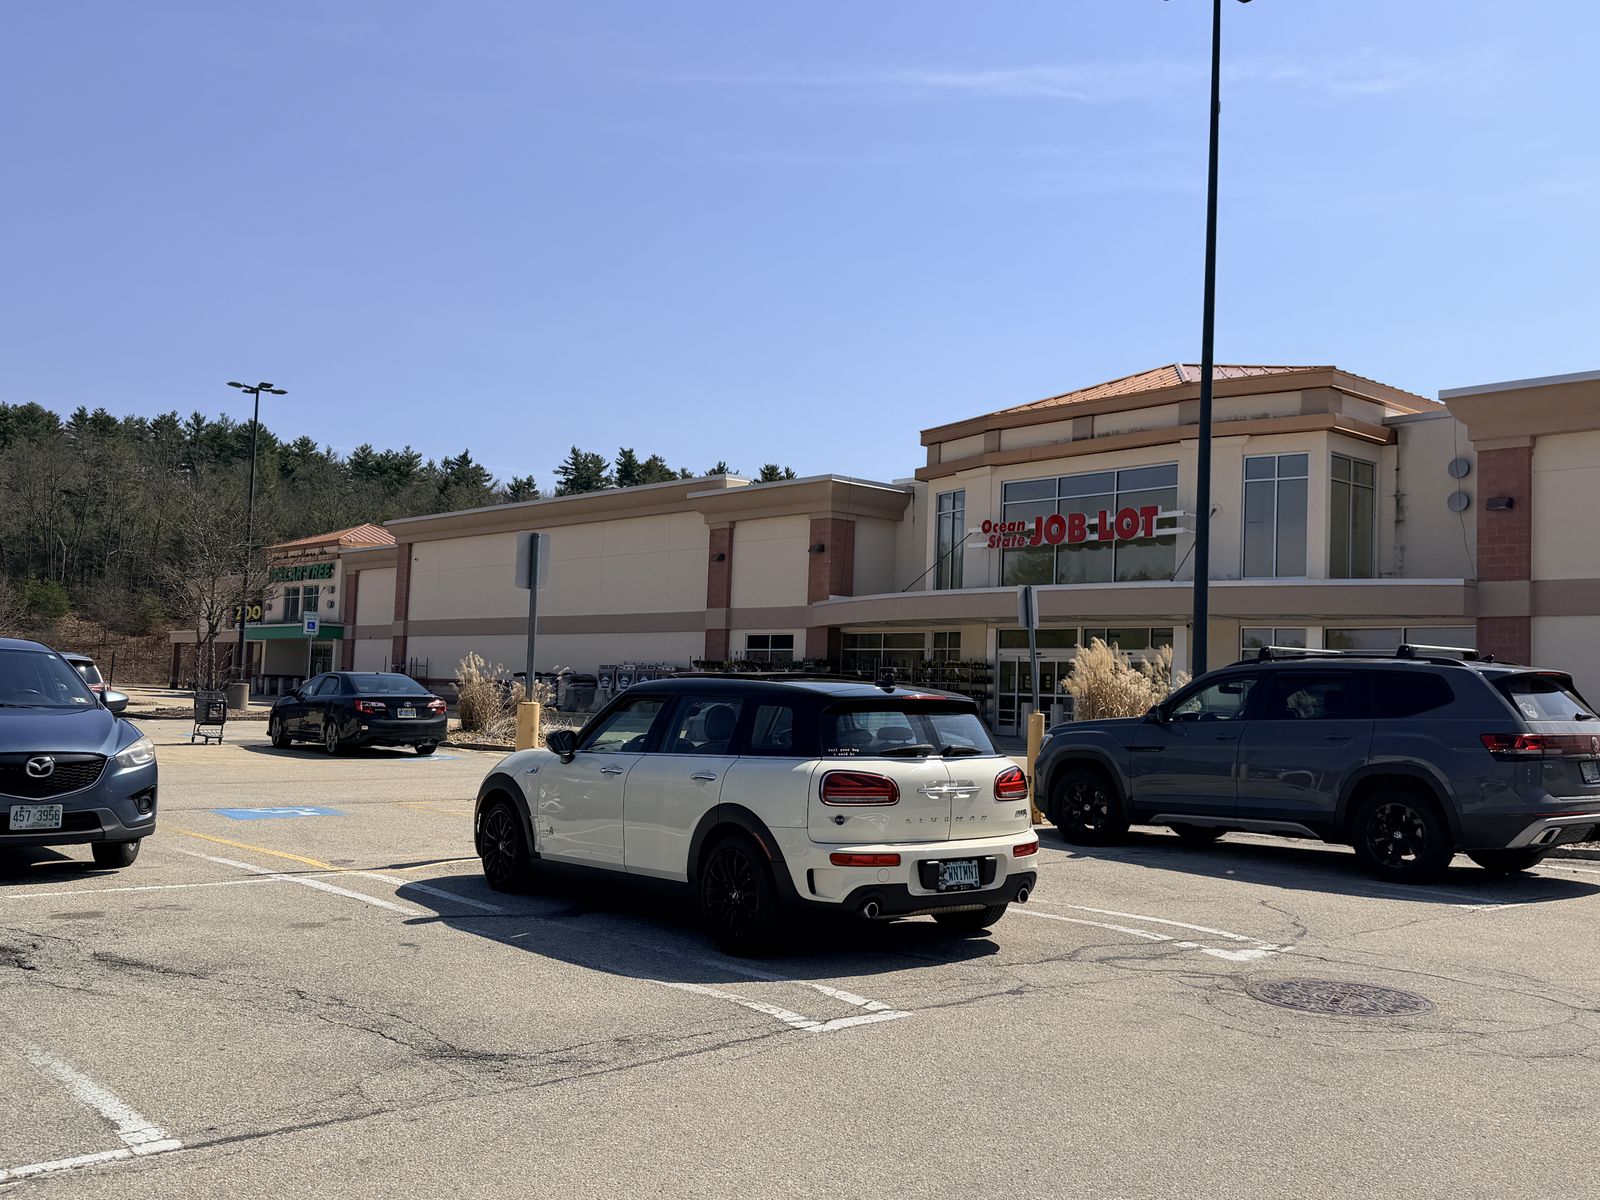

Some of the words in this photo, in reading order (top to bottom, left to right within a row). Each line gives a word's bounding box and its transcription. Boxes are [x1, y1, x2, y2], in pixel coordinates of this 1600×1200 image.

[981, 519, 1026, 534] Ocean
[1029, 512, 1088, 546] JOB
[1098, 505, 1160, 541] LOT
[987, 534, 1025, 549] State
[13, 810, 31, 822] 457
[36, 809, 60, 822] 3956
